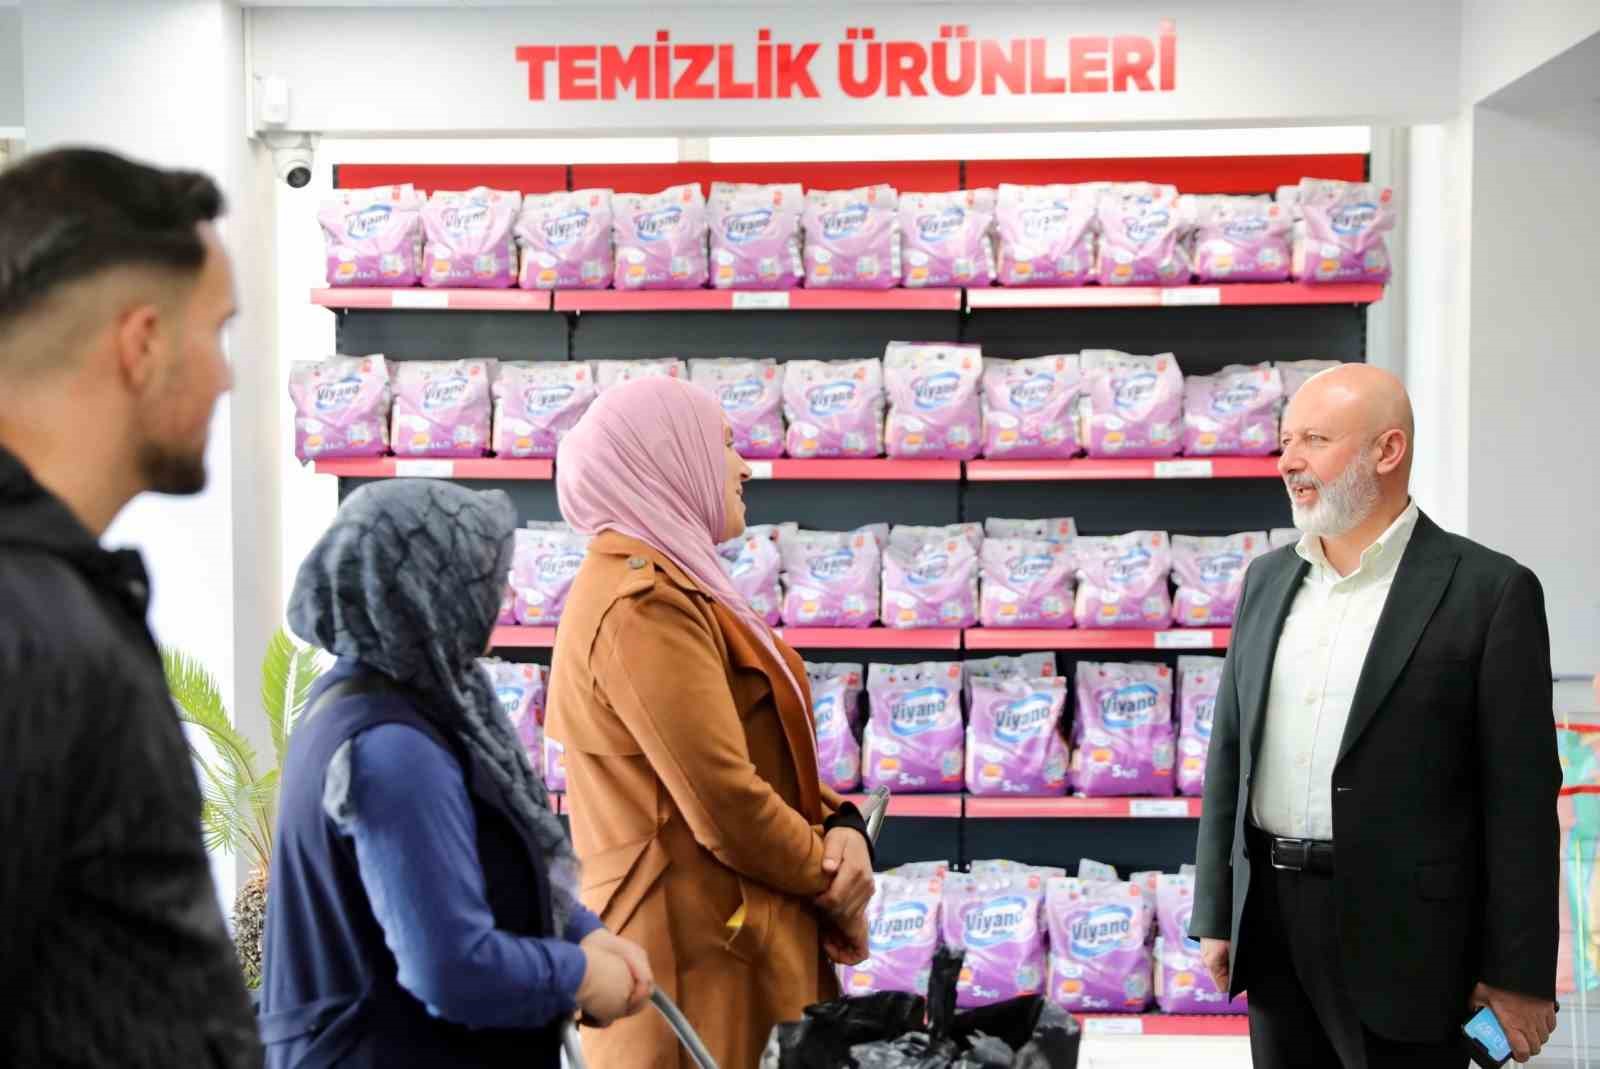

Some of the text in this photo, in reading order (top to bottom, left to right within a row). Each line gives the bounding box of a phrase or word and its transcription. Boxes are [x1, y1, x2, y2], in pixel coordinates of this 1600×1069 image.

[516, 19, 1177, 100] TEMİZLİK ÜRÜNLERİ
[891, 699, 945, 722] Viyano
[996, 705, 1050, 727] Viyano
[1103, 695, 1156, 715] Viyano
[869, 914, 925, 937] Viyano
[966, 911, 1024, 934] Viyano
[1072, 917, 1130, 941] Viyano
